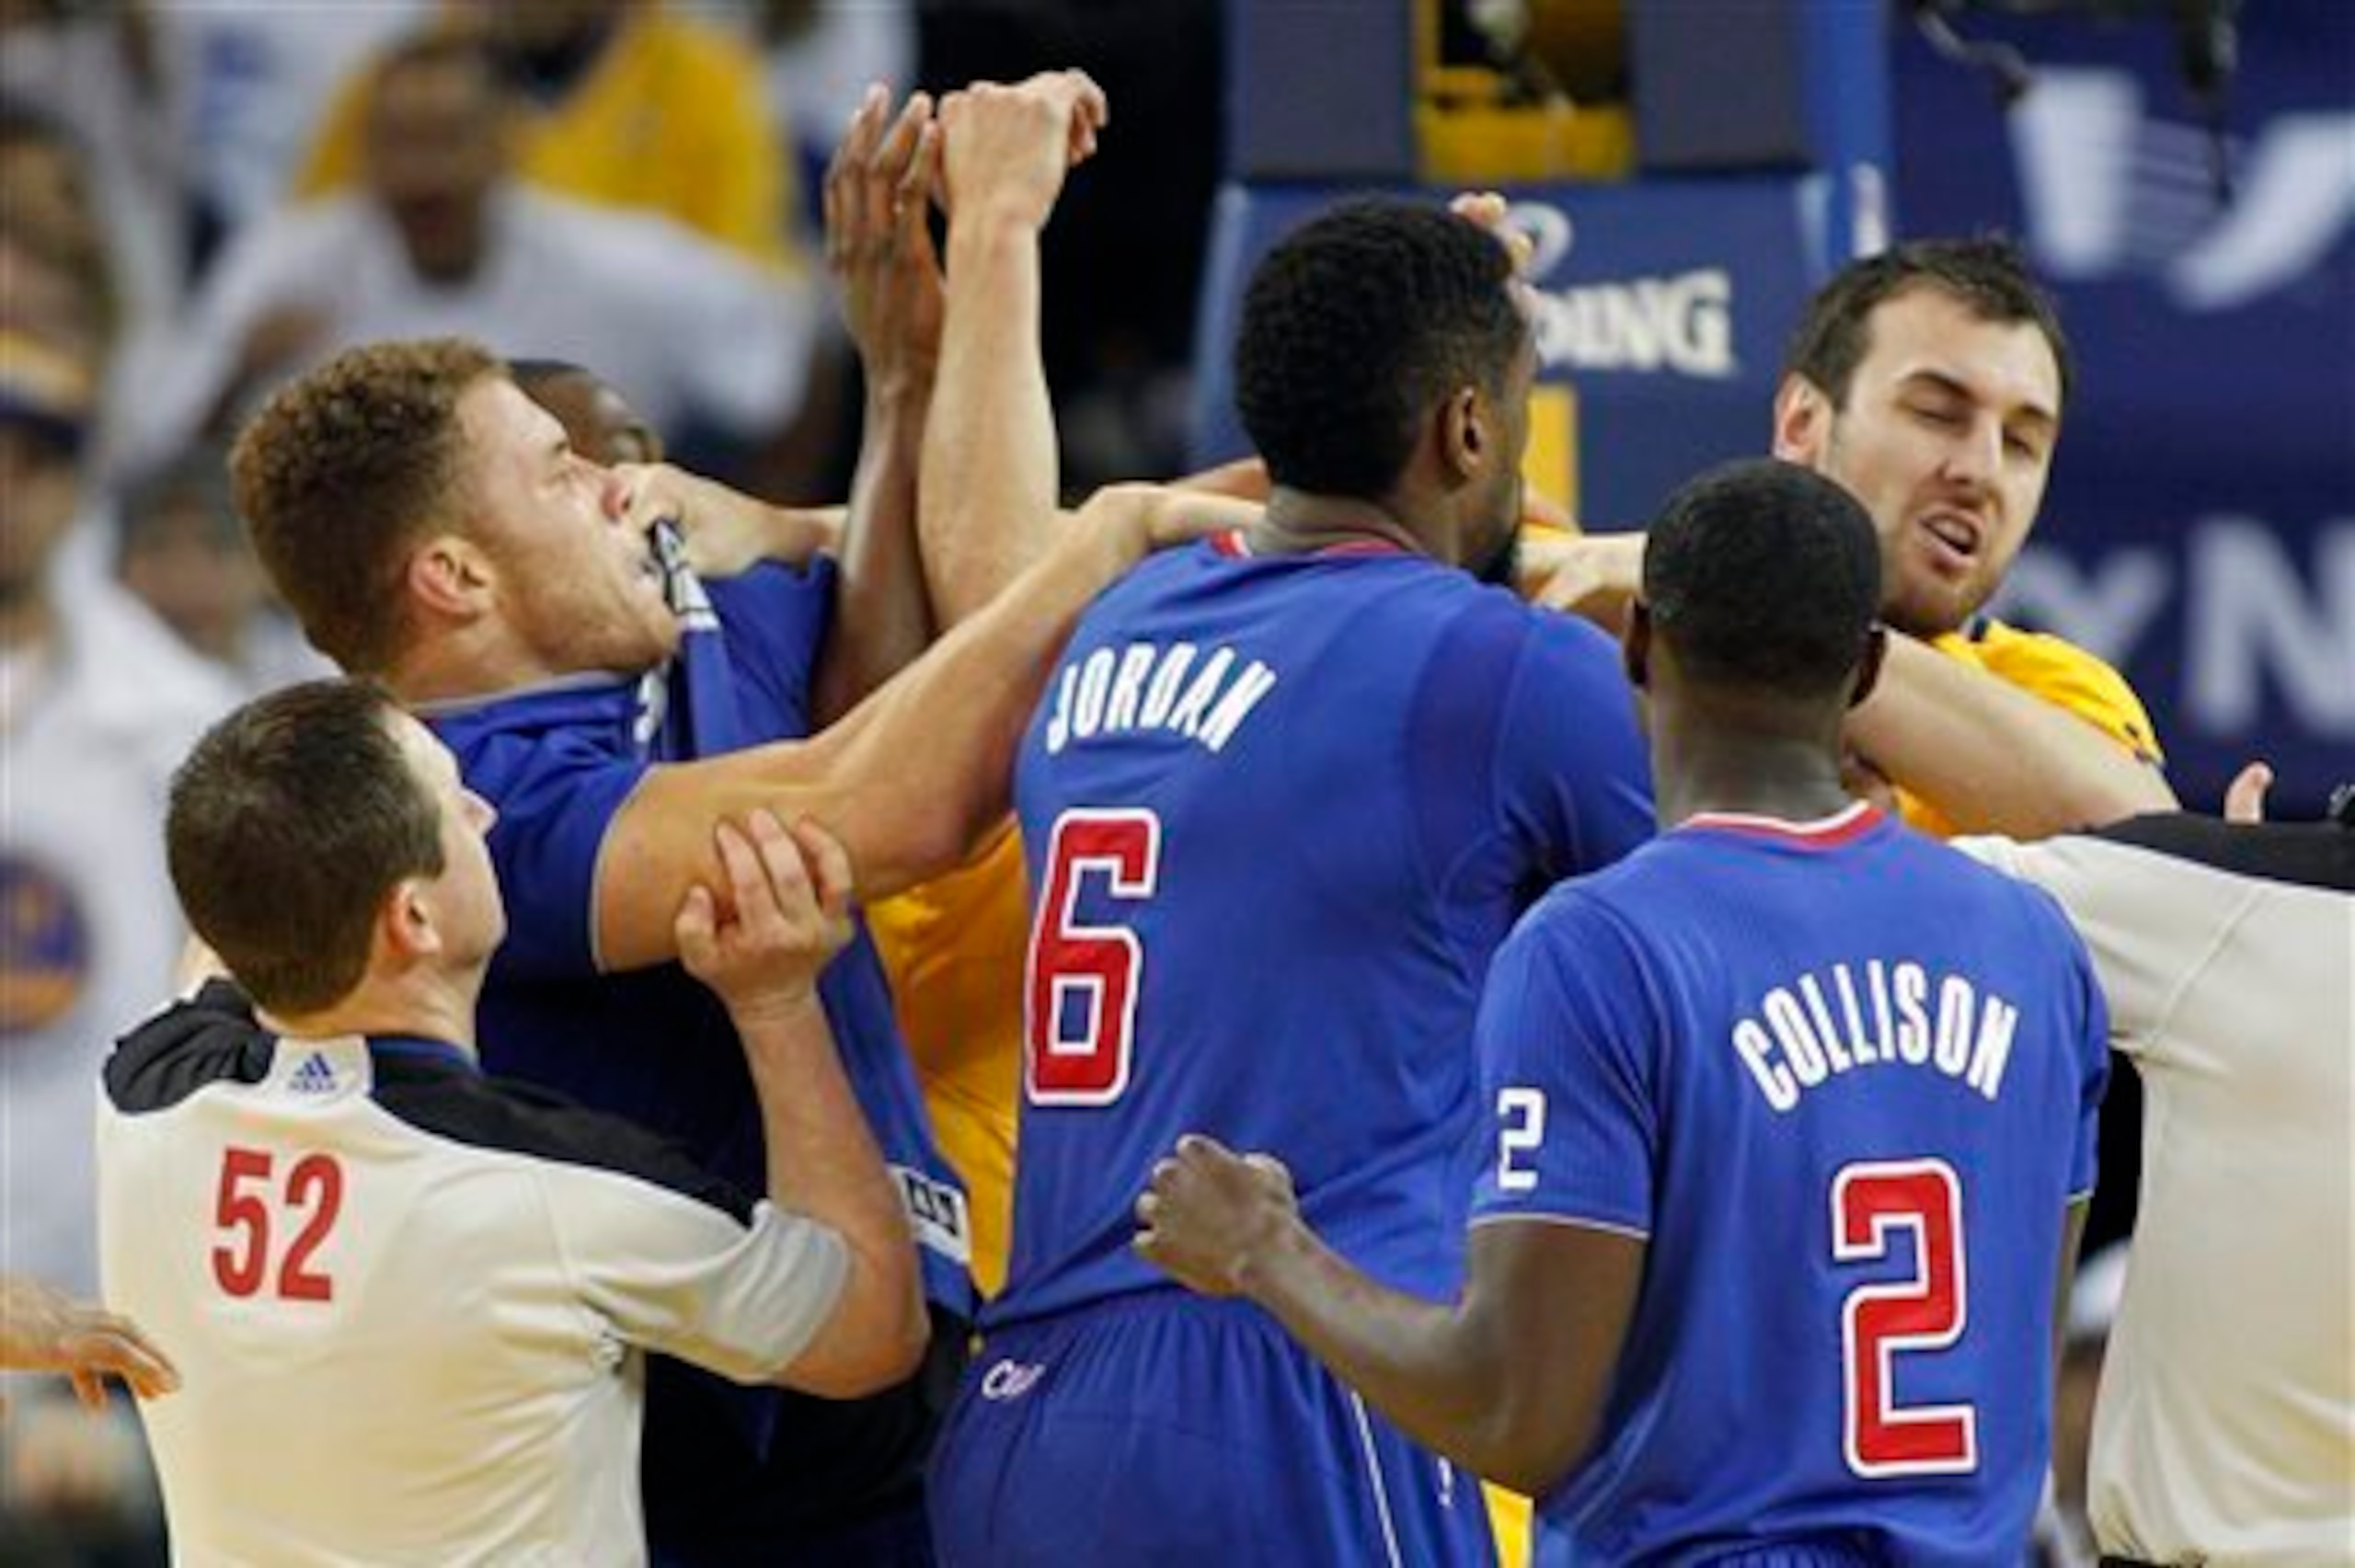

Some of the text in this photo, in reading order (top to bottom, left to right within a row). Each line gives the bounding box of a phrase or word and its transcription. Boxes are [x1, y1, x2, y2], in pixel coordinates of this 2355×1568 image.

[1047, 643, 1277, 755] JORDAN
[1025, 807, 1161, 1106] 6
[1731, 959, 2017, 1113] COLLISON
[1497, 1087, 1545, 1190] 2
[213, 1148, 342, 1301] 52
[1831, 1156, 1976, 1479] 2
